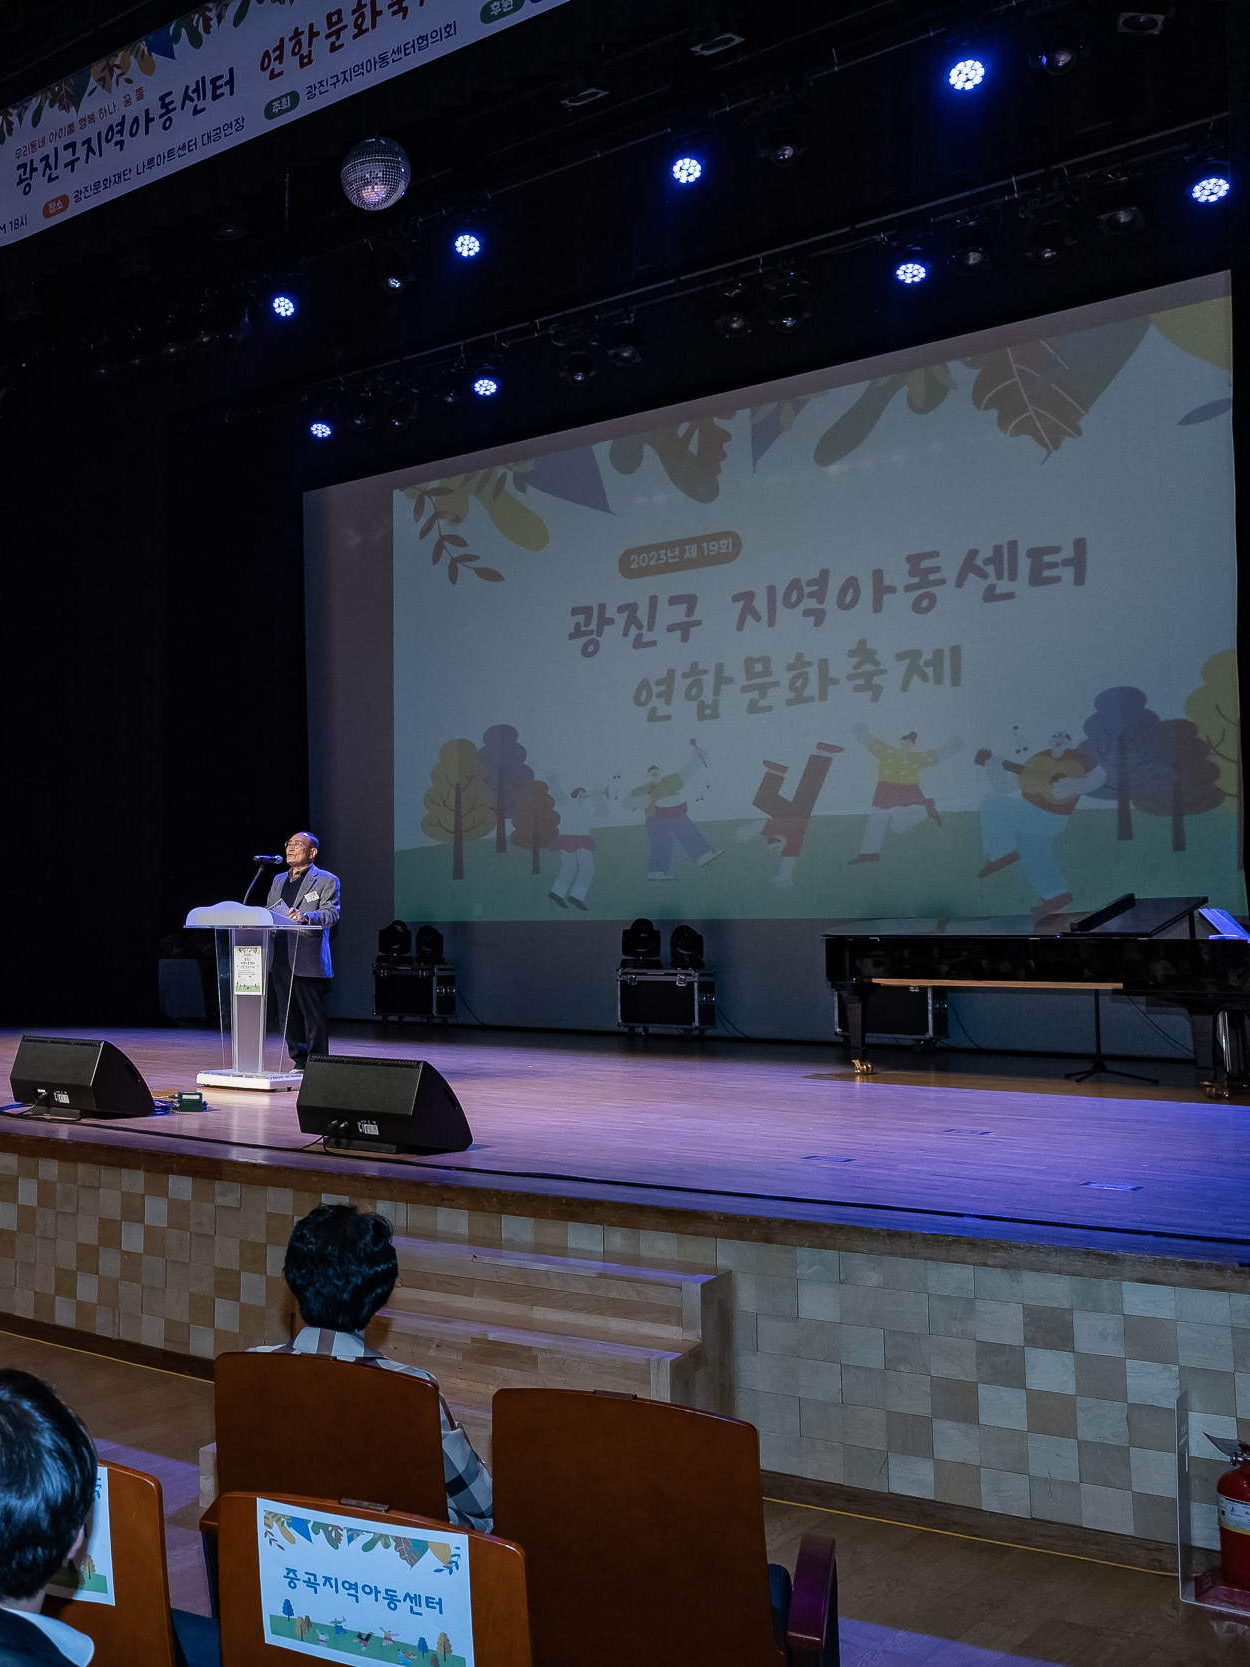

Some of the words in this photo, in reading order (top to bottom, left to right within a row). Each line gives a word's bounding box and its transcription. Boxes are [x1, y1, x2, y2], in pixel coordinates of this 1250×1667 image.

[272, 95, 291, 114] 주최
[305, 20, 457, 100] 광진구지역아동센터협의회
[15, 135, 46, 160] 우리동네
[50, 122, 75, 142] 아이들
[79, 112, 96, 130] 행복
[123, 93, 132, 108] 꿈
[16, 66, 235, 196] 광진구지역아동센터
[48, 199, 63, 213] 장소
[73, 167, 132, 203] 광진문화재단
[136, 137, 198, 176] 나루아트센터
[201, 116, 245, 147] 대공연장
[9, 213, 28, 232] 18시
[630, 546, 680, 569] 2023년
[684, 543, 698, 560] 제
[702, 537, 733, 557] 19회
[567, 594, 703, 658] 광진구
[732, 536, 1089, 632] 지역아동센터
[632, 638, 963, 724] 연합문화축제
[283, 1566, 444, 1616] 중곡지역아동센터
